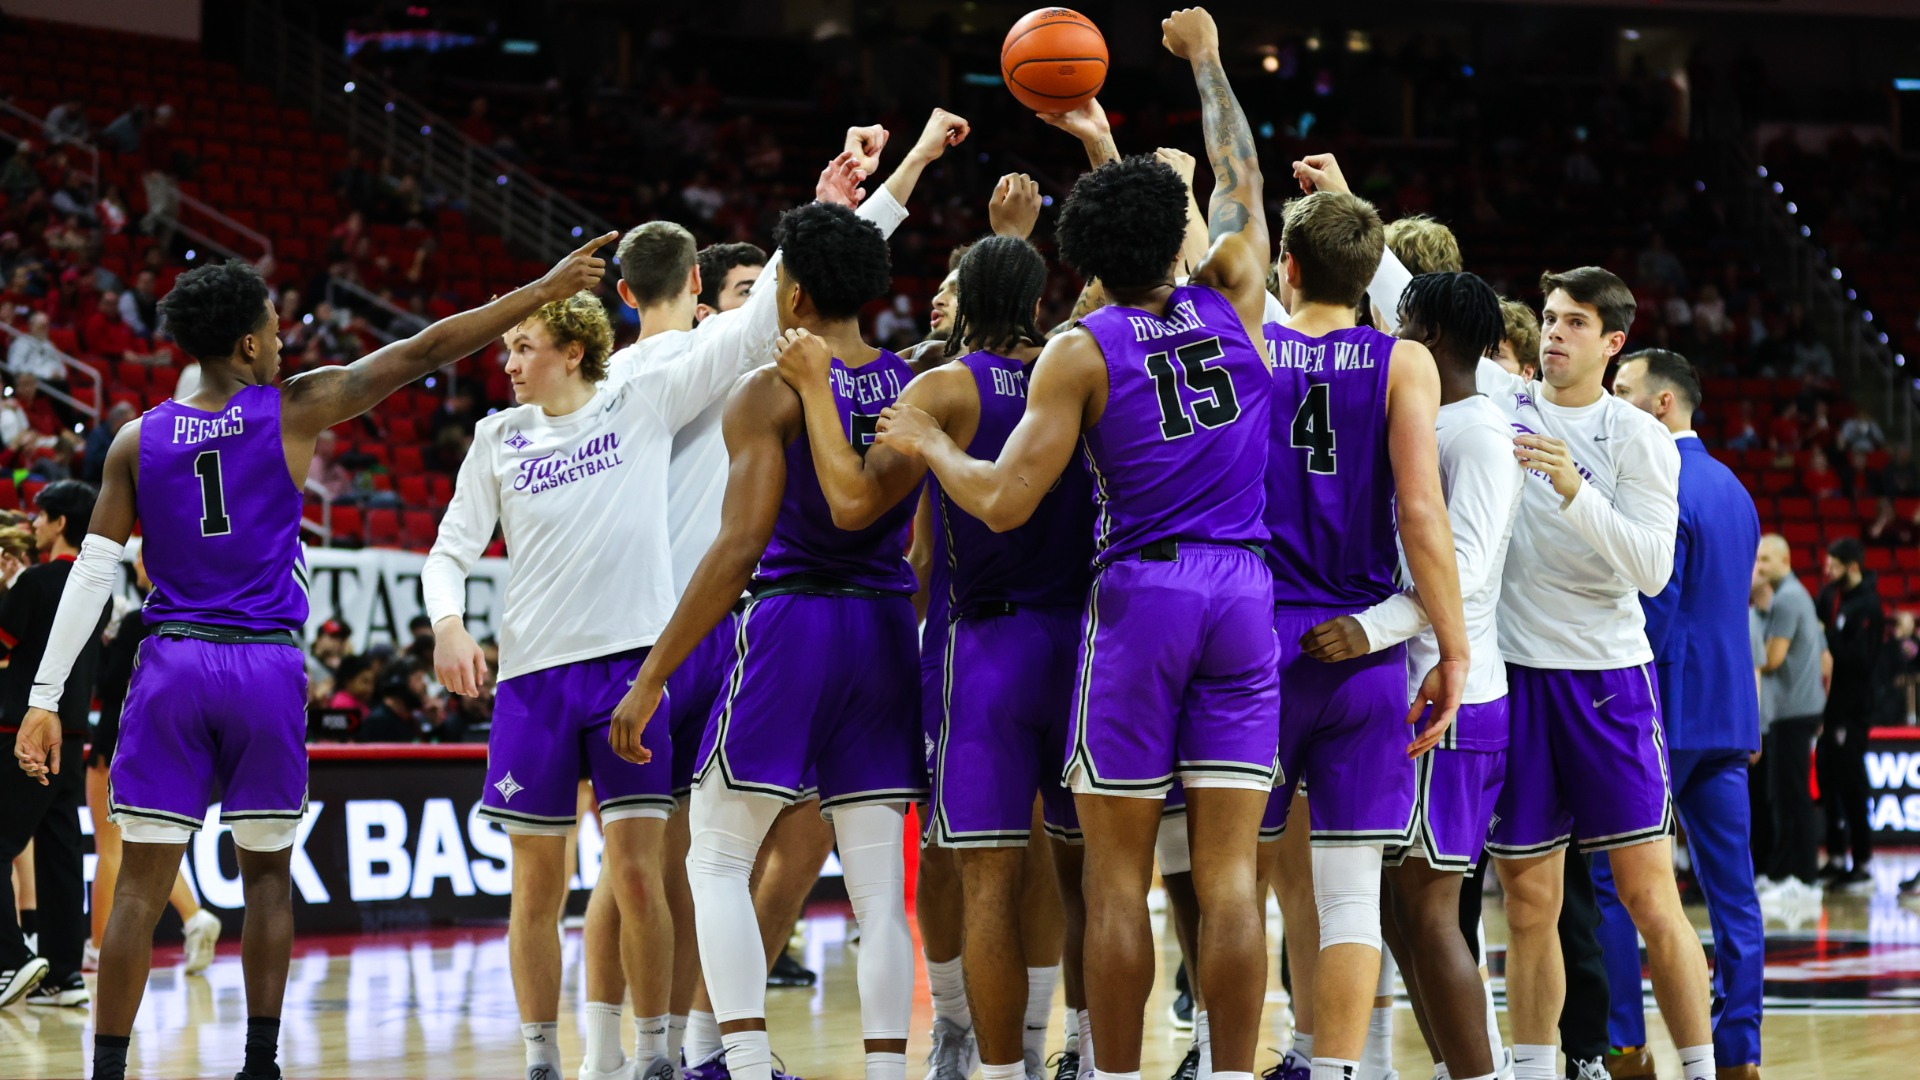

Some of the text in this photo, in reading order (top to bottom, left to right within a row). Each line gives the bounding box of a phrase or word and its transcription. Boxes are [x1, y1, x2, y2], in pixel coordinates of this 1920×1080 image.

[1334, 341, 1375, 370] WAL
[990, 366, 1027, 399] BOT
[1144, 335, 1242, 442] 15
[172, 405, 244, 444] PEGUES
[1290, 382, 1337, 476] 4
[193, 449, 232, 538] 1
[531, 452, 624, 495] BASKETBALL
[1868, 793, 1920, 831] AS
